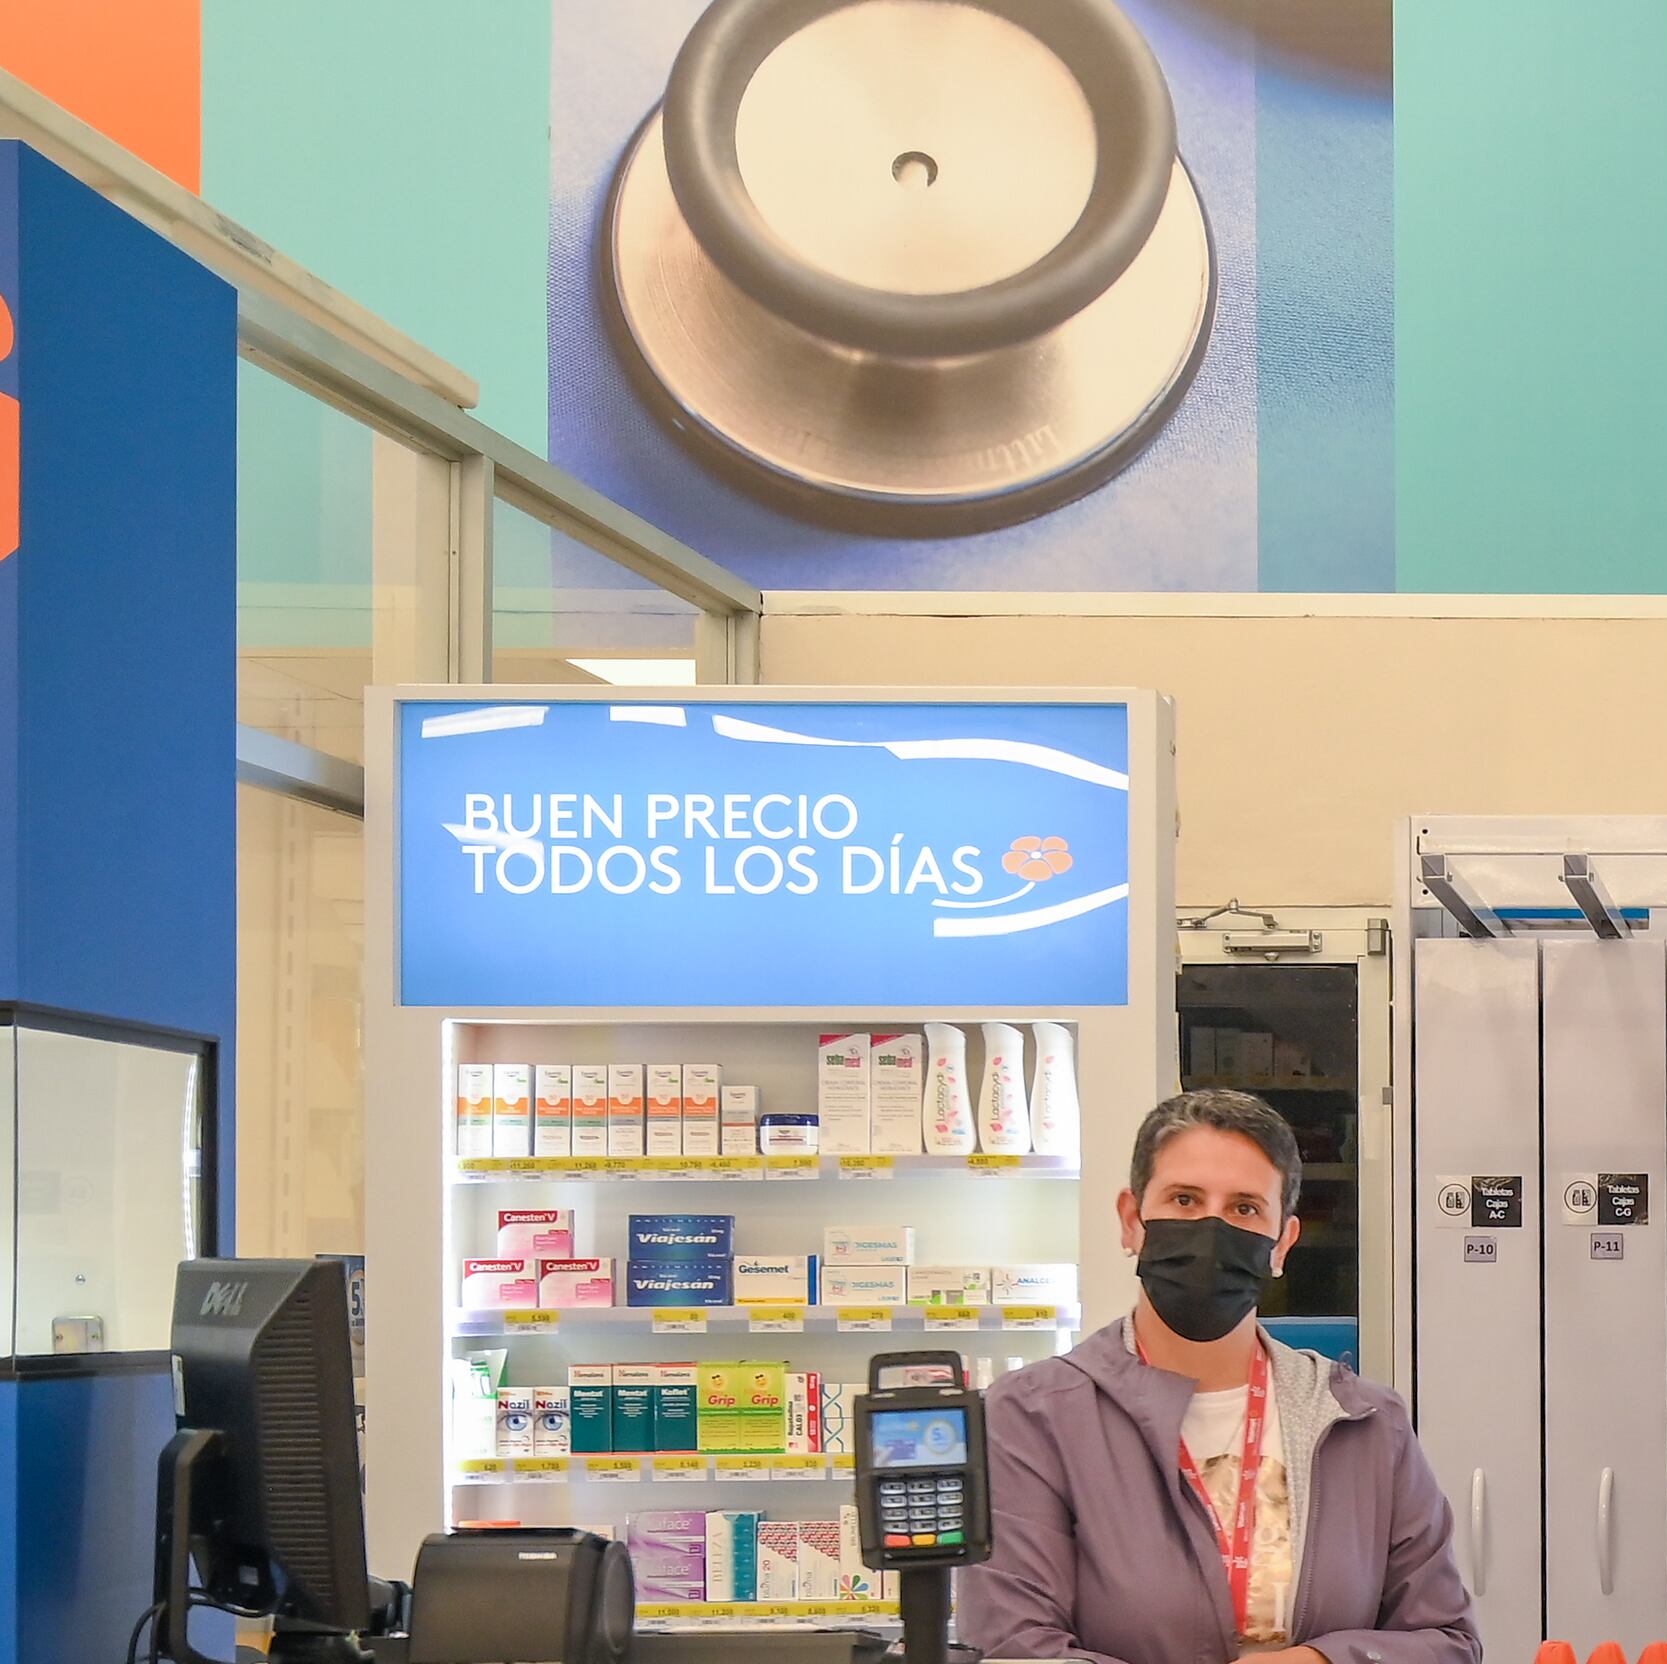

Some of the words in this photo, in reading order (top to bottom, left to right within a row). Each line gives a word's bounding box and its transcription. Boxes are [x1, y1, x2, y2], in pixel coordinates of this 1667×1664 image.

[463, 793, 624, 839] BUEN
[647, 793, 858, 839] PRECIO
[462, 845, 681, 895] TODOS
[705, 845, 819, 895] LOS
[843, 834, 983, 896] DÍAS
[936, 1071, 946, 1122] Lactacyd
[990, 1071, 1000, 1122] Lactacyd
[1482, 1186, 1513, 1197] Tabletas
[1607, 1184, 1639, 1195] Tabletas
[1486, 1199, 1508, 1209] Cajas
[1612, 1197, 1635, 1207] Cajas
[637, 1233, 717, 1245] Viajesán
[1467, 1244, 1494, 1255] P-10
[1594, 1241, 1620, 1252] P-11
[738, 1264, 789, 1274] Gesemet
[498, 1399, 530, 1410] Nazil
[708, 1394, 736, 1408] Grip
